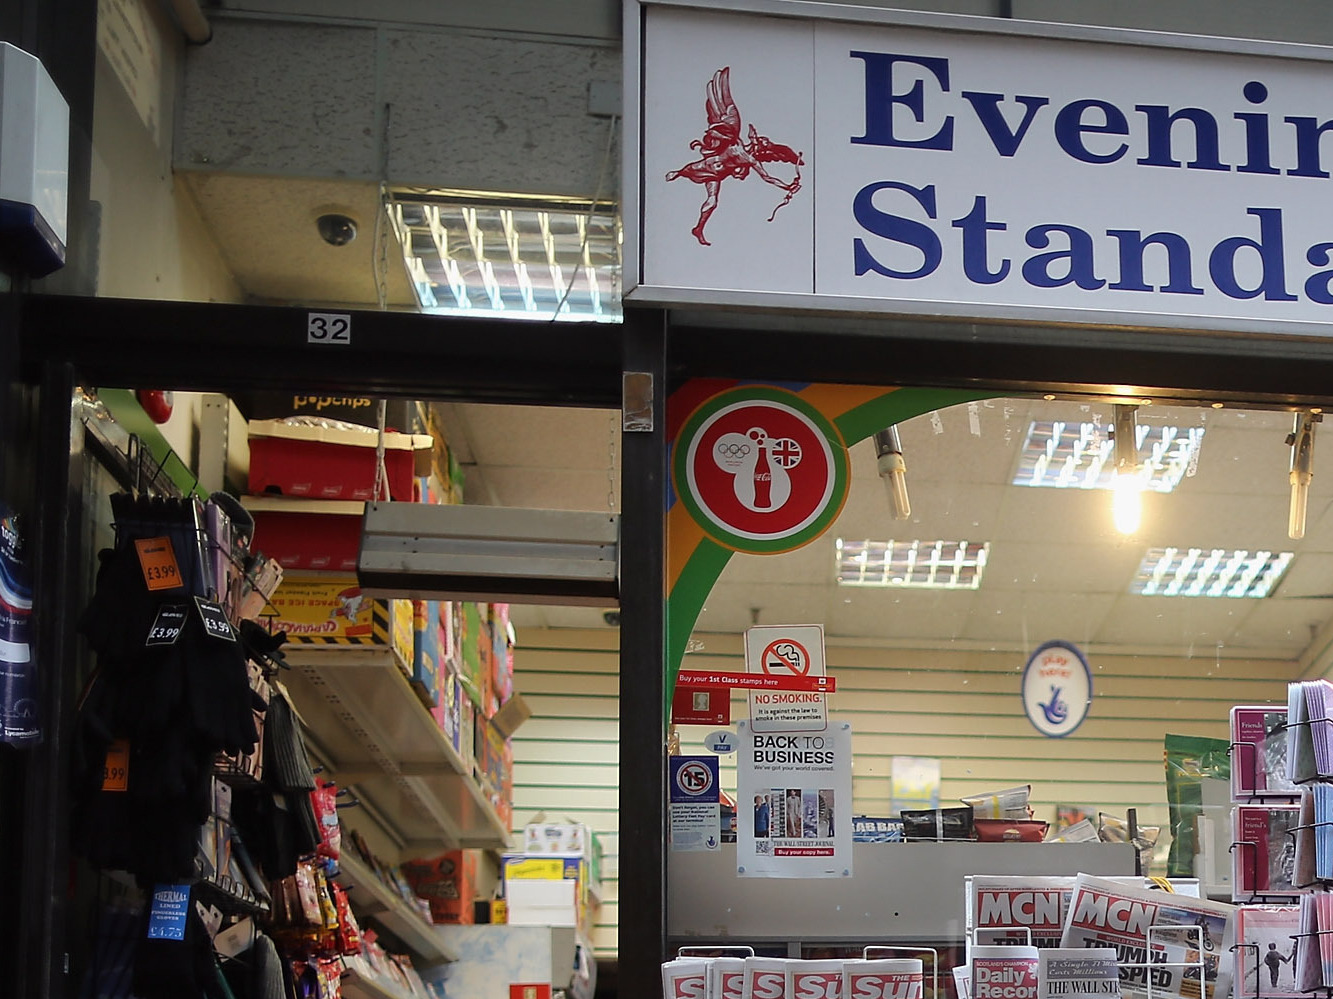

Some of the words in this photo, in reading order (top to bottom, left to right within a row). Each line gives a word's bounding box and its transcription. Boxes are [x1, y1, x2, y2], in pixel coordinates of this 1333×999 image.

[309, 318, 350, 342] 32
[147, 565, 175, 580] £3.99
[204, 616, 229, 633] £3.99
[150, 627, 180, 639] £3.99
[678, 674, 691, 683] Buy
[692, 675, 707, 683] your
[708, 675, 720, 683] 1st
[721, 675, 738, 683] Class
[739, 677, 762, 685] stamps
[763, 678, 778, 686] here
[754, 694, 769, 704] NO
[771, 693, 822, 704] SMOKING.
[769, 707, 790, 715] against
[798, 713, 821, 721] premises
[1240, 721, 1262, 729] Friends
[753, 735, 798, 748] BACK
[803, 736, 824, 749] TO
[753, 750, 835, 764] BUSINESS
[683, 771, 705, 787] 15
[154, 891, 188, 902] THERMAL
[979, 892, 1061, 925] MCN
[1072, 891, 1156, 936] MCN
[149, 926, 182, 938] £4.75
[976, 967, 1026, 987] Daily
[1118, 963, 1172, 988] SPIED
[975, 983, 1039, 999] Recor
[1047, 980, 1069, 995] THE
[1071, 980, 1100, 994] WALL
